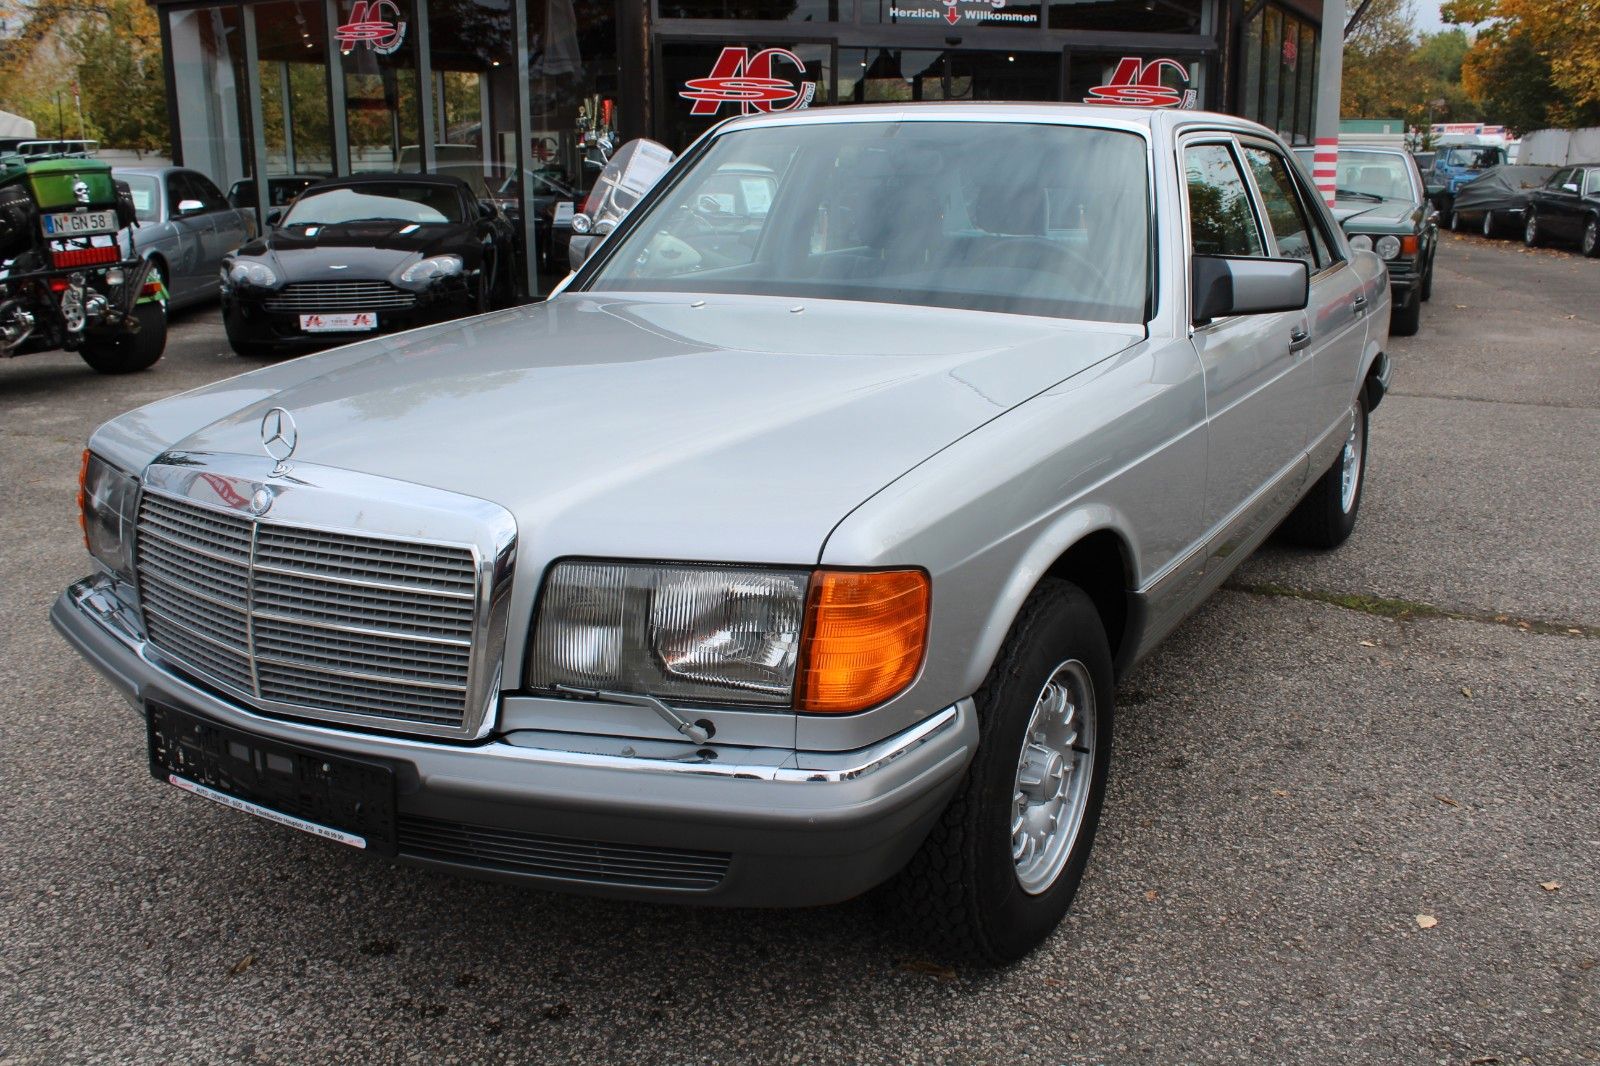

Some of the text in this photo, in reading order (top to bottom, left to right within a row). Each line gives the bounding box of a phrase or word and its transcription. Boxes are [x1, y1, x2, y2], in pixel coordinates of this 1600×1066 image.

[889, 7, 1038, 22] Herzlich Willkommen
[55, 215, 105, 231] N GN 58
